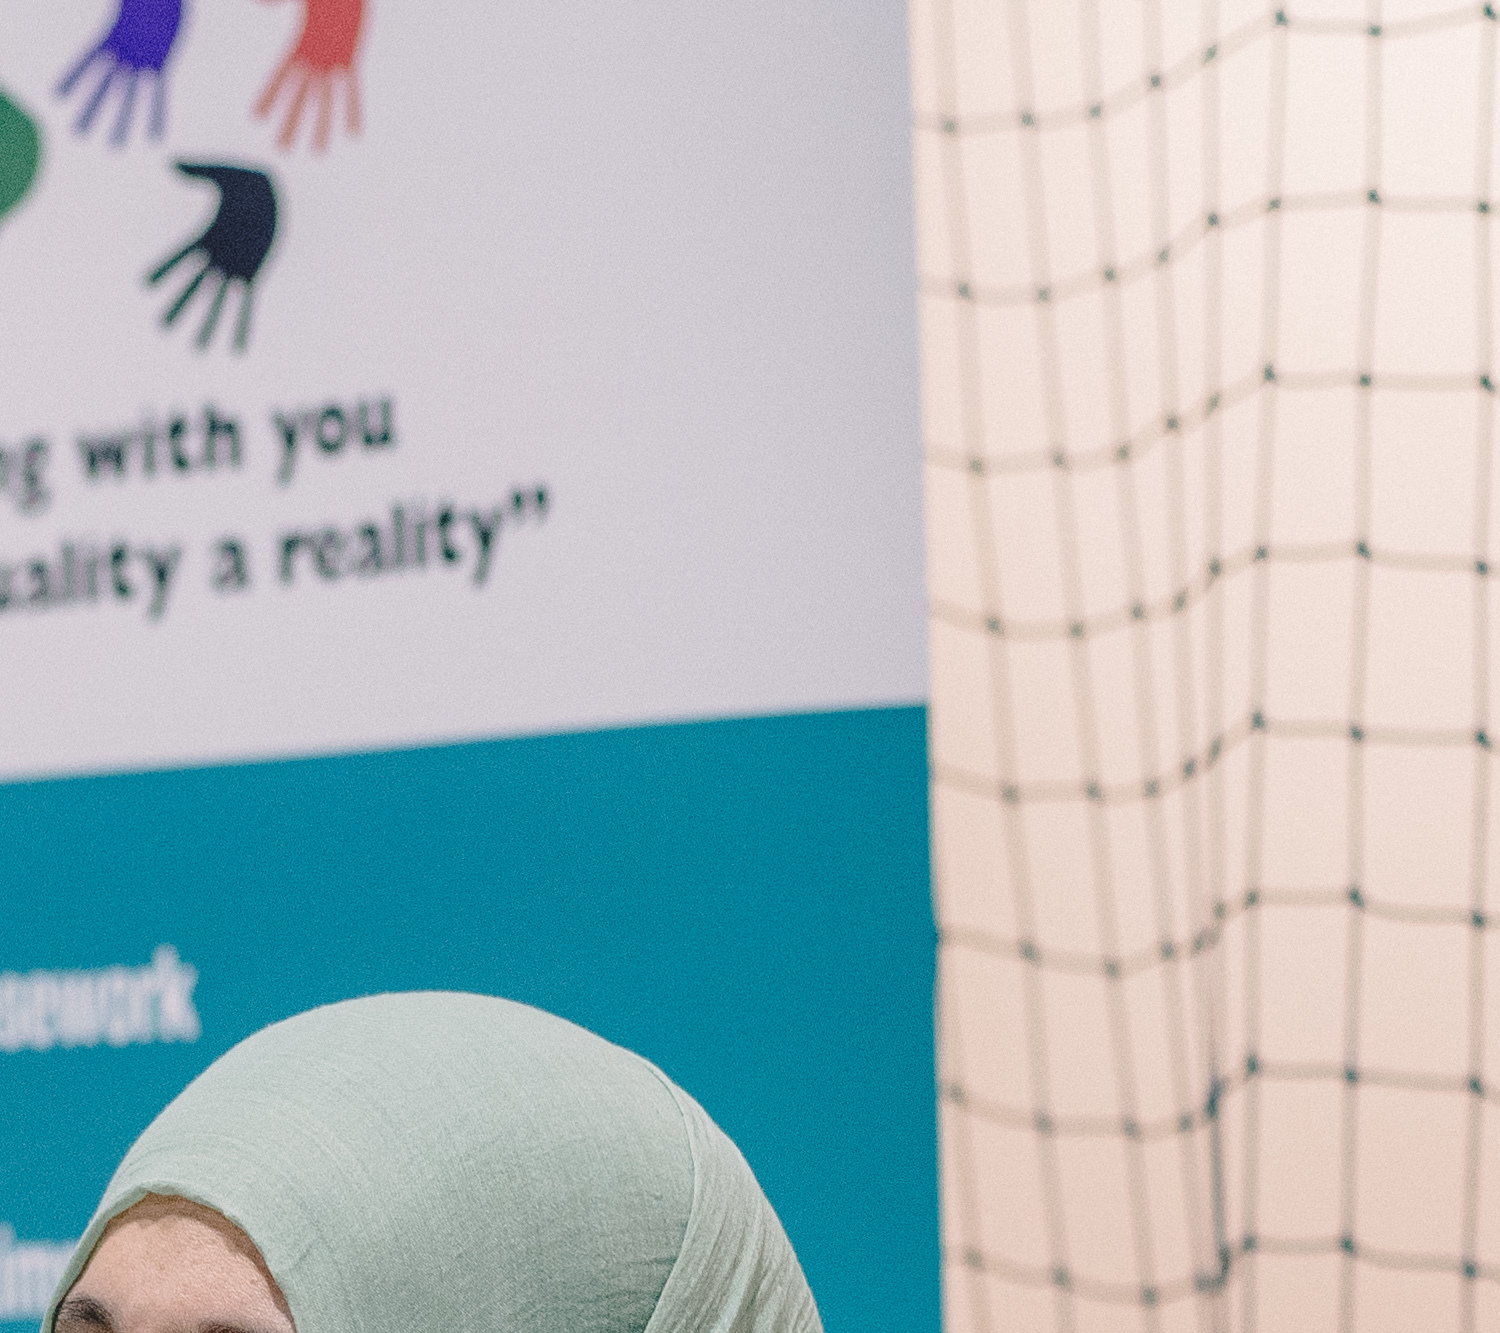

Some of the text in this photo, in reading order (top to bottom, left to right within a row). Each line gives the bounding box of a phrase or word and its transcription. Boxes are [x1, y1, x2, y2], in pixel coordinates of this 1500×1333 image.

[77, 401, 243, 481] with
[271, 395, 398, 487] you
[212, 537, 250, 591] a
